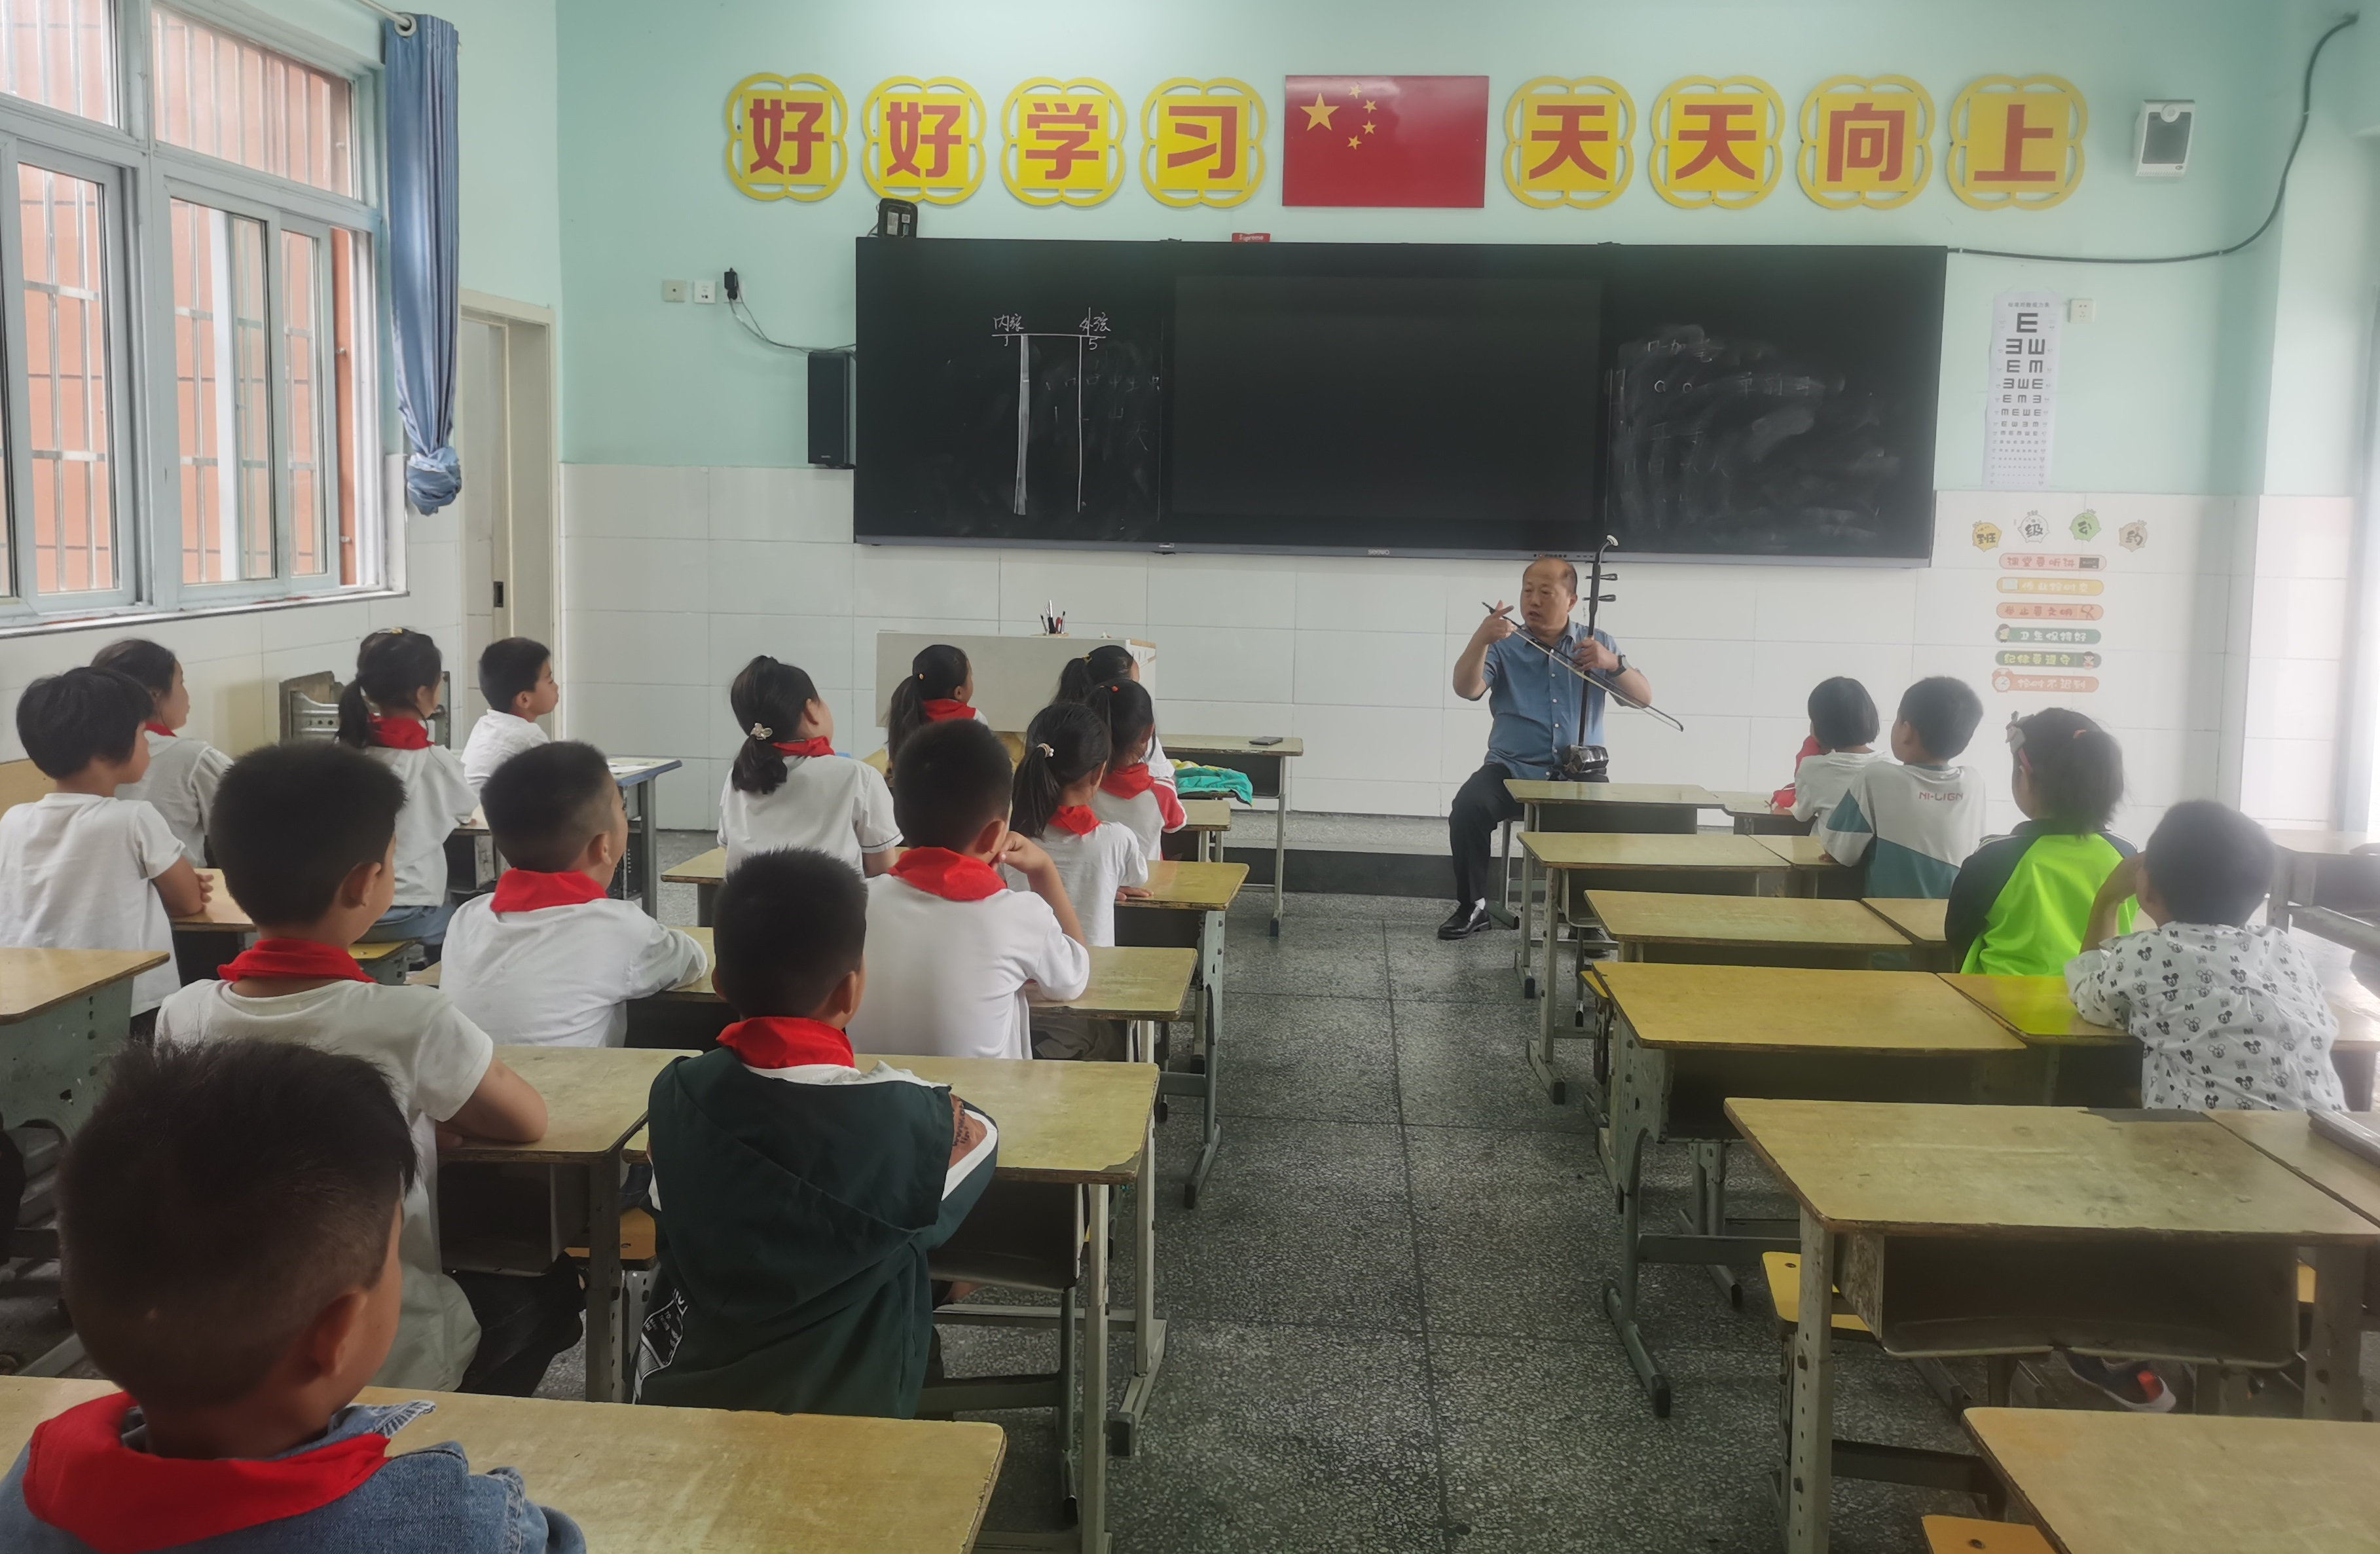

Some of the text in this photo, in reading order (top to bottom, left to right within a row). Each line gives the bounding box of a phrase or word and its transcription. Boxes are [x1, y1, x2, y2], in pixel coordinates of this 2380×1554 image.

[749, 98, 2056, 182] 好好学习 天天向上
[2020, 630, 2087, 642] 卫生保持好
